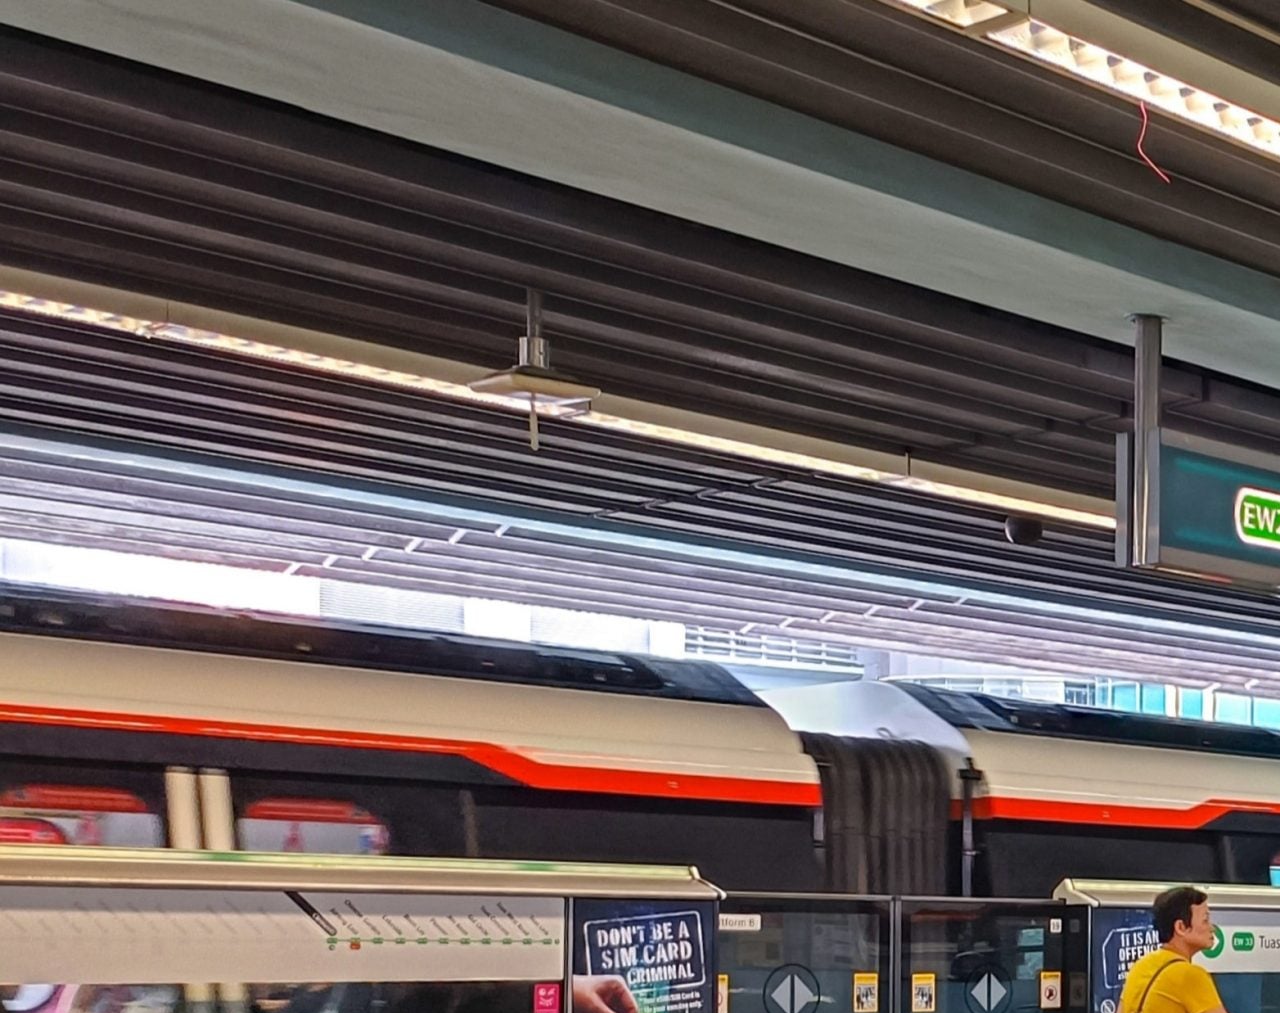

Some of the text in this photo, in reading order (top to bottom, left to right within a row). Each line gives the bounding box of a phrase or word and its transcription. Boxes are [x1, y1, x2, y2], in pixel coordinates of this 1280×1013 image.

[597, 920, 690, 947] DON'T BE A
[1121, 930, 1159, 947] IT IS AN
[1259, 935, 1280, 949] Tuas
[601, 941, 693, 969] SIM CARD
[627, 962, 695, 985] CRIMINAL
